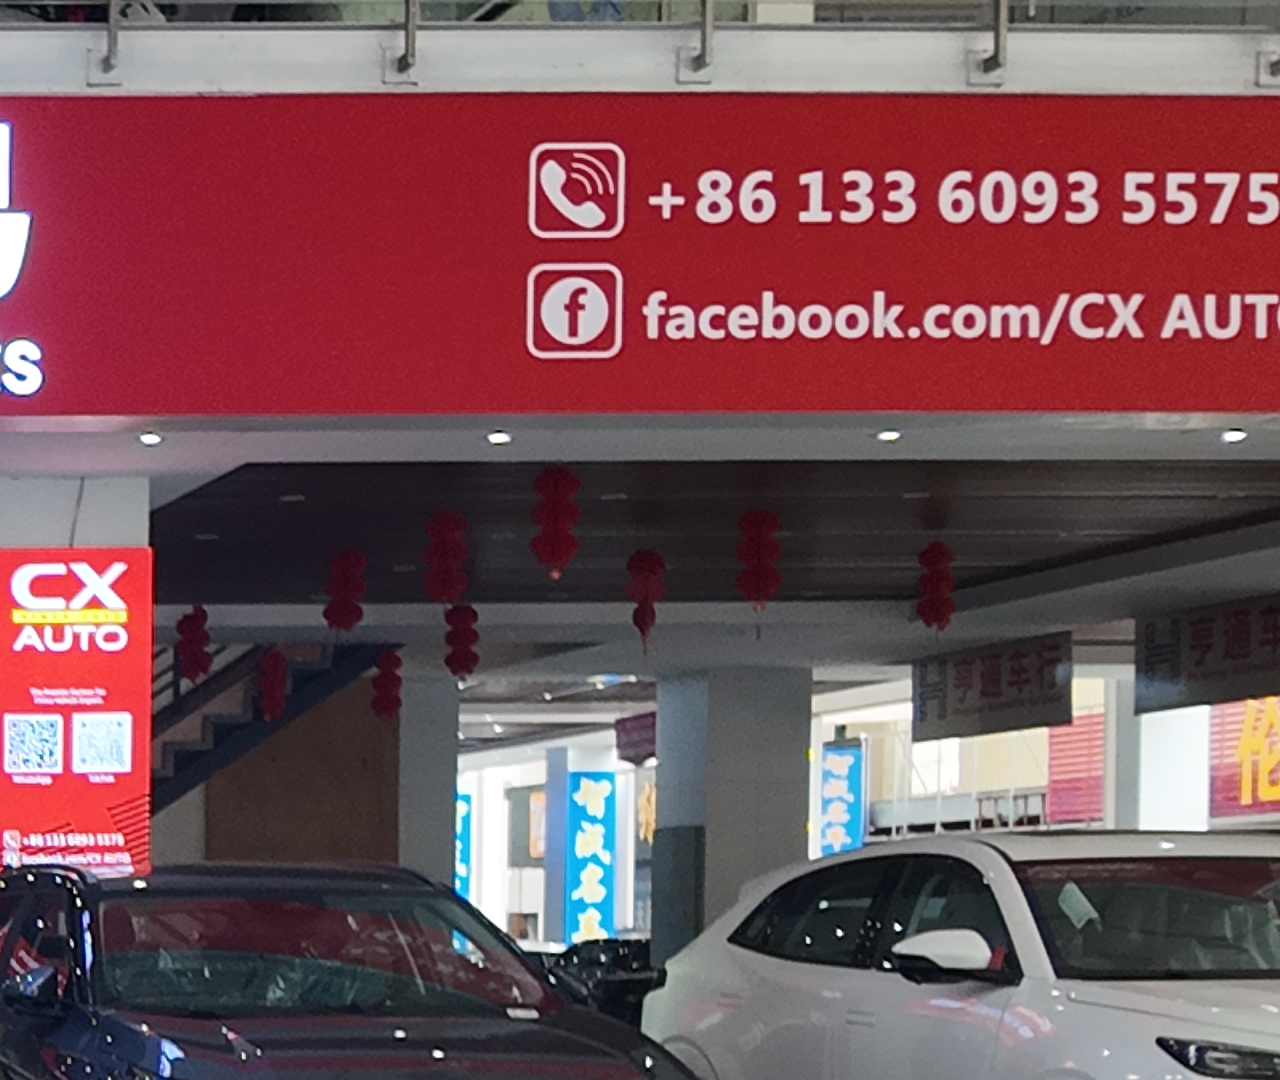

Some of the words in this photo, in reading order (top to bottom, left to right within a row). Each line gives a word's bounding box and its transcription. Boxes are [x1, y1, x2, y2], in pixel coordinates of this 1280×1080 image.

[648, 169, 777, 224] +86
[798, 169, 917, 224] 133
[937, 170, 1099, 224] 6093
[1122, 171, 1280, 225] 5575
[641, 290, 1145, 346] facebook.com/CX
[1160, 293, 1280, 340] AUT
[10, 561, 129, 610] CX
[12, 624, 129, 653] AUTO
